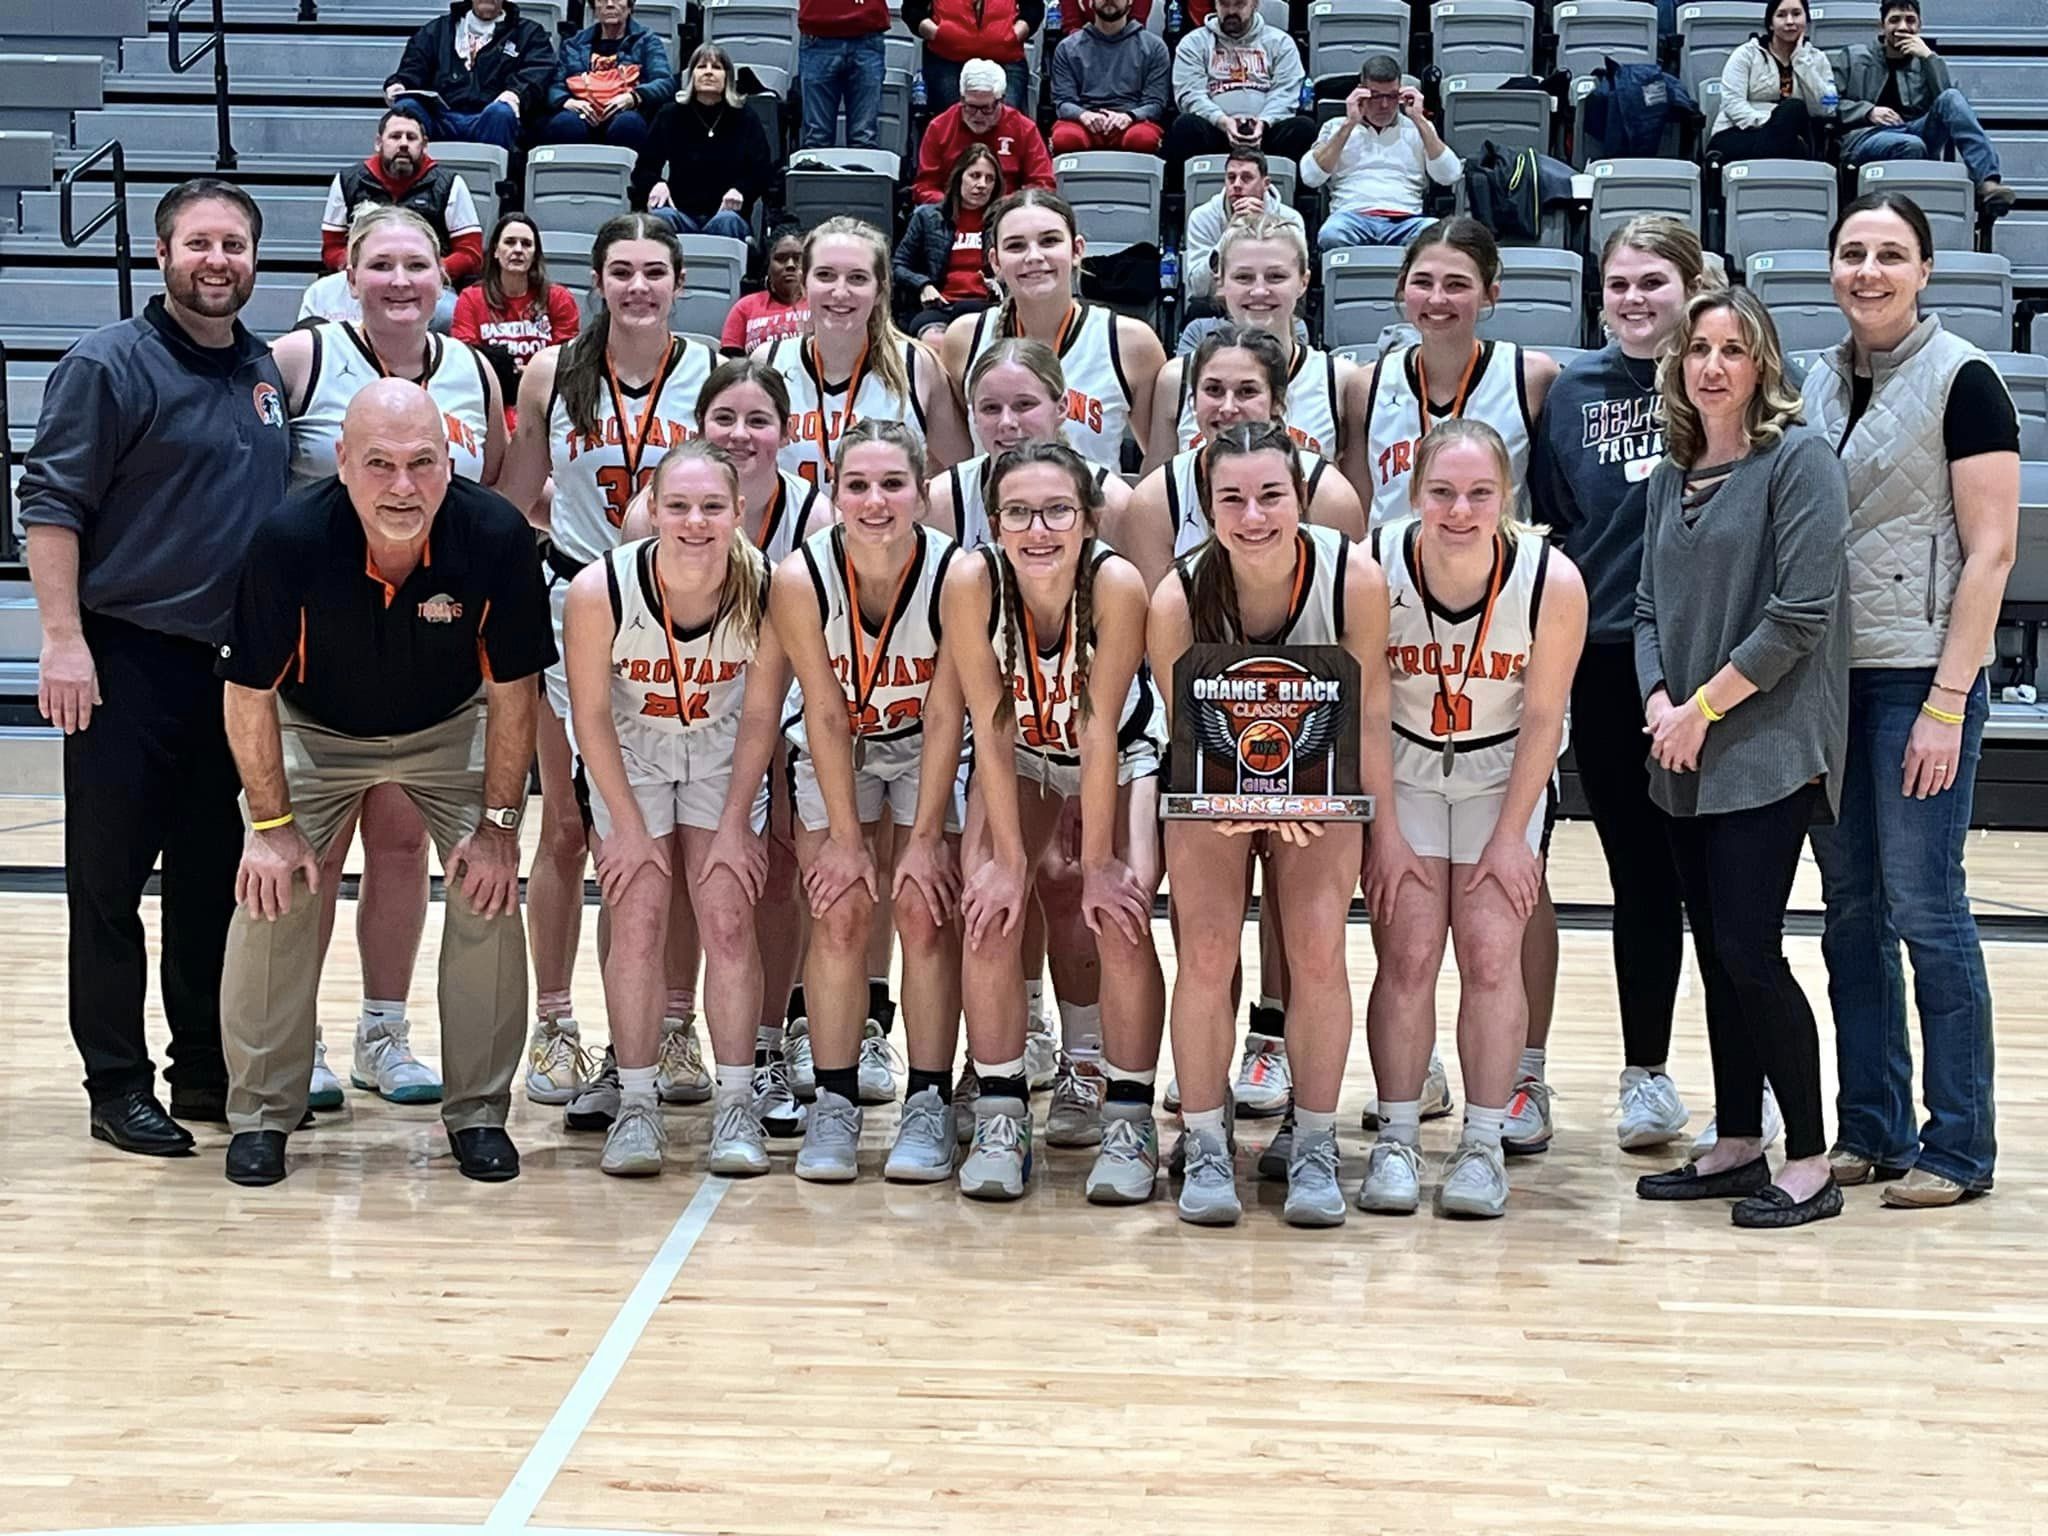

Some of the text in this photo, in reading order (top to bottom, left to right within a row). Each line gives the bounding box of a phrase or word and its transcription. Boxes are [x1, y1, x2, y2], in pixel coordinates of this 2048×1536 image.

[480, 319, 552, 341] BASKETBA
[566, 415, 698, 462] TROJAN
[1598, 432, 1663, 464] TROJA
[596, 465, 656, 529] 3
[621, 657, 748, 684] ROJAN
[1193, 678, 1267, 701] ORANGE
[1279, 681, 1340, 702] BLACK
[1232, 703, 1299, 718] CLASSIC
[1242, 778, 1287, 793] GIRLS
